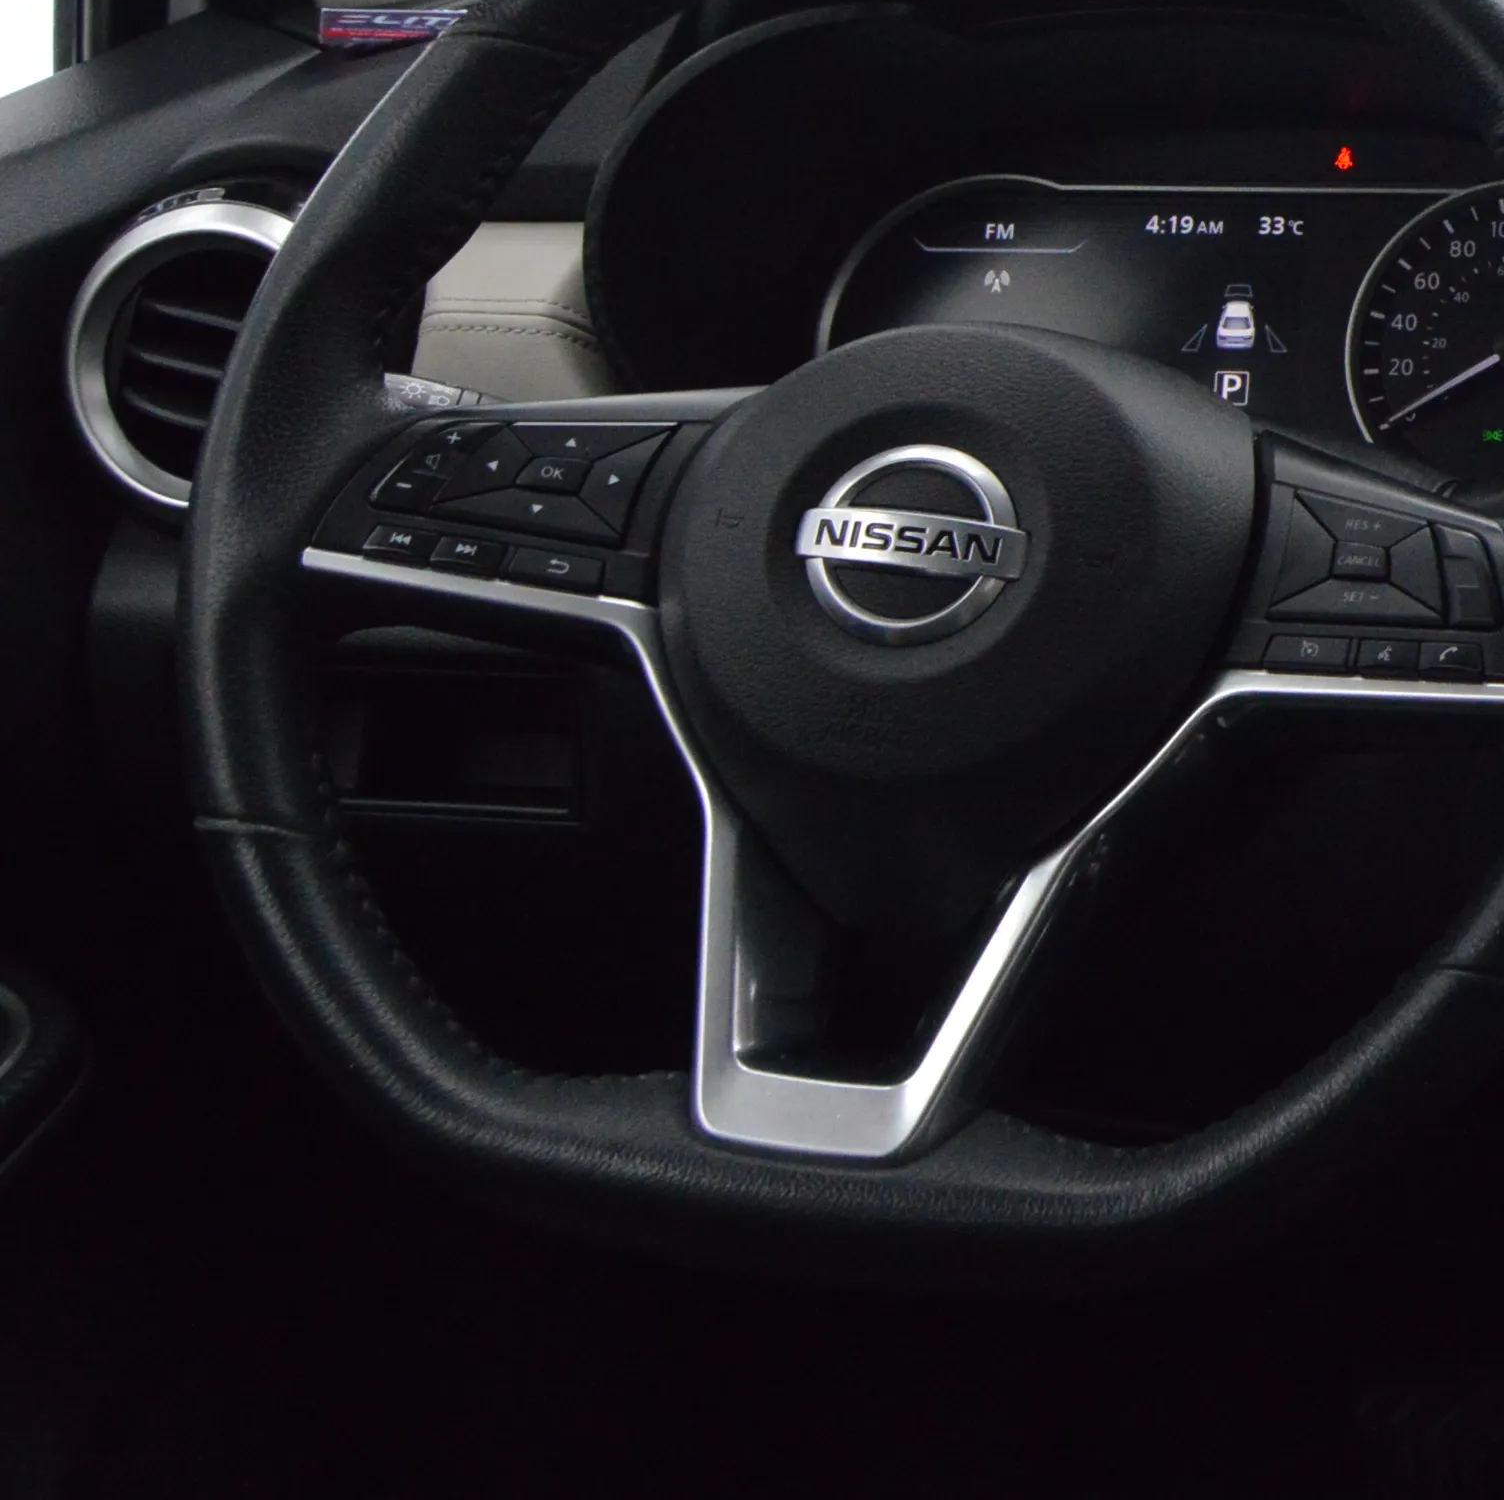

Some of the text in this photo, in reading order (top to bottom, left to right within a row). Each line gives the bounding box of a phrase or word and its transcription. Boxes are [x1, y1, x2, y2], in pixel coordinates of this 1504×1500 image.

[984, 223, 1015, 240] FM
[1144, 215, 1224, 235] 4:19 AM
[1449, 240, 1476, 258] 80
[1413, 272, 1441, 291] 60
[1453, 291, 1470, 303] 40
[1390, 313, 1418, 332] 40
[1431, 337, 1447, 349] 20
[1388, 357, 1414, 377] 20
[1221, 374, 1242, 400] P
[540, 466, 562, 479] OK
[815, 518, 1003, 564] NISSAN
